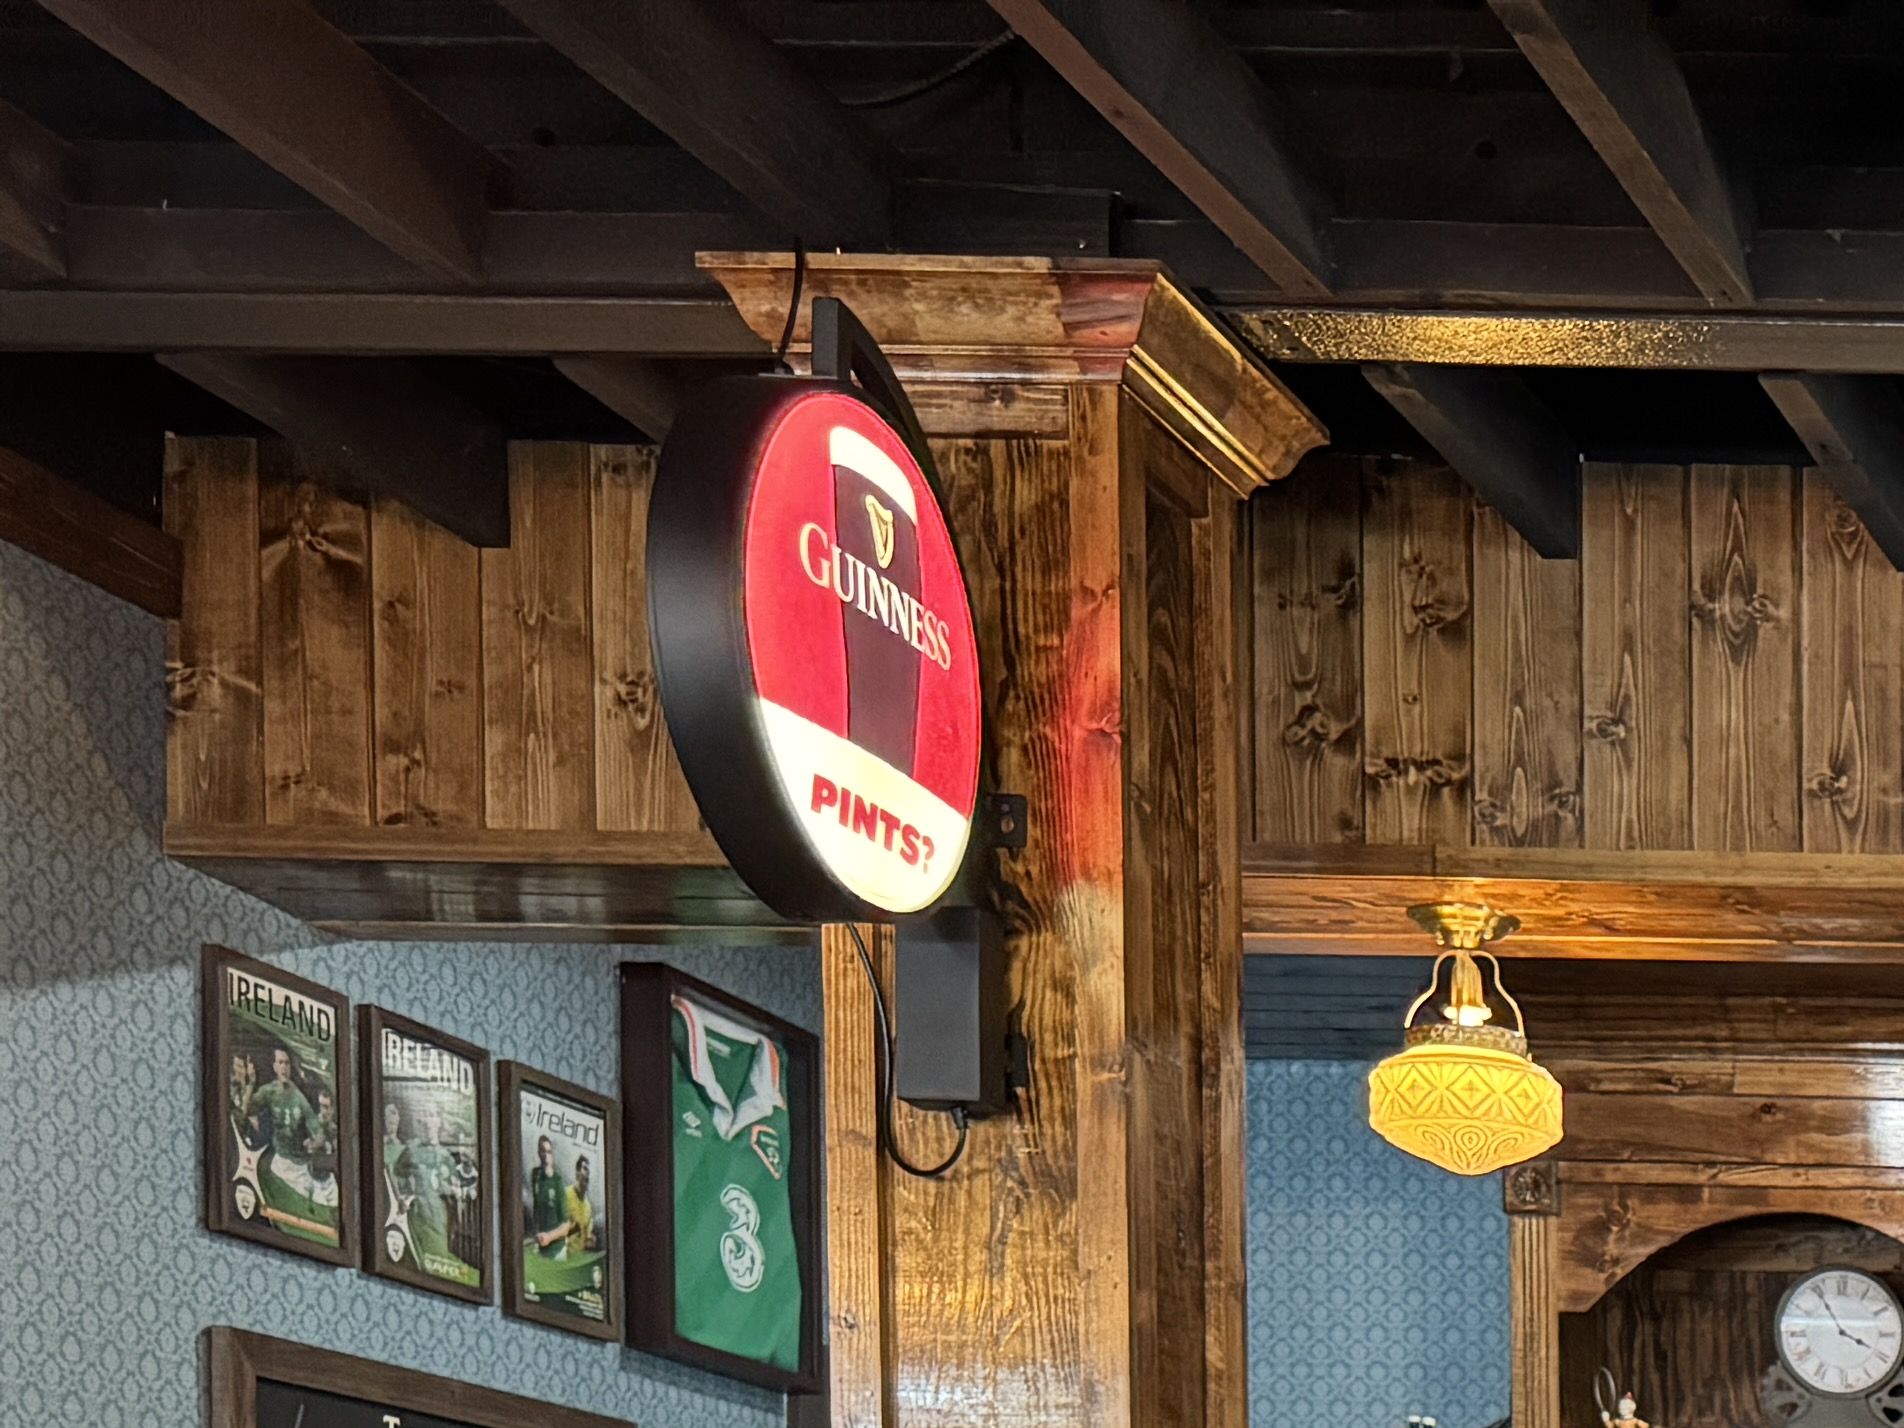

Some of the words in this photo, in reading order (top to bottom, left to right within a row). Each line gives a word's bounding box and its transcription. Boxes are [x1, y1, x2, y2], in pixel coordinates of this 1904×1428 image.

[800, 522, 952, 672] GUINNESS
[810, 773, 935, 874] PINTS?
[228, 971, 332, 1043] IRELAND
[384, 1027, 475, 1095] IRELAND
[535, 1102, 600, 1147] Ireland
